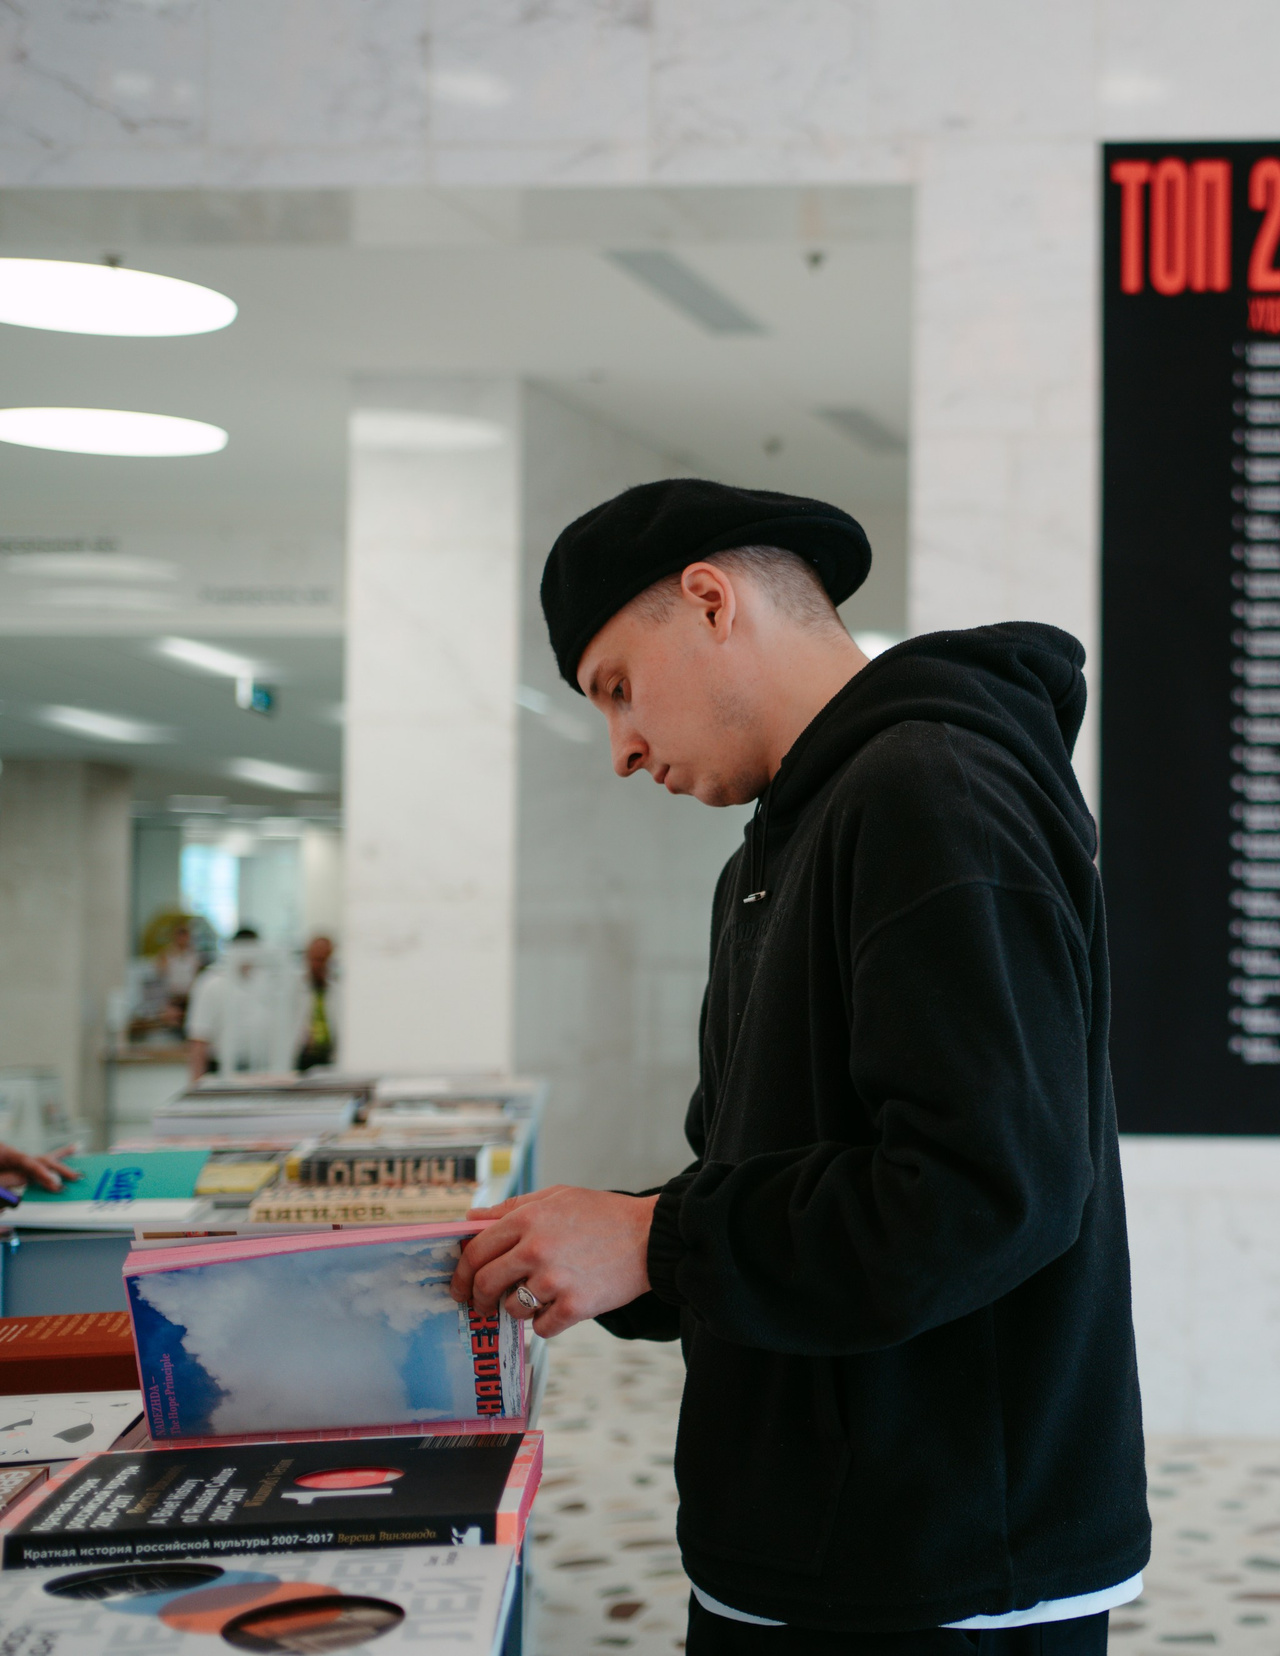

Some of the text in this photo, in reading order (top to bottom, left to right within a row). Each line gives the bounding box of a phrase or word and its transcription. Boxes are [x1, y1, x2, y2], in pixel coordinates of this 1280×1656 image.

[1111, 158, 1232, 295] ТОП
[160, 1353, 176, 1396] Principle
[168, 1396, 180, 1420] Hope
[23, 1548, 76, 1560] Краткая
[80, 1545, 132, 1557] история
[135, 1538, 210, 1556] российской
[213, 1536, 270, 1549] культуры
[271, 1532, 334, 1545] 2007–2017
[337, 1532, 376, 1545] Версия
[378, 1528, 437, 1542] Винзавода
